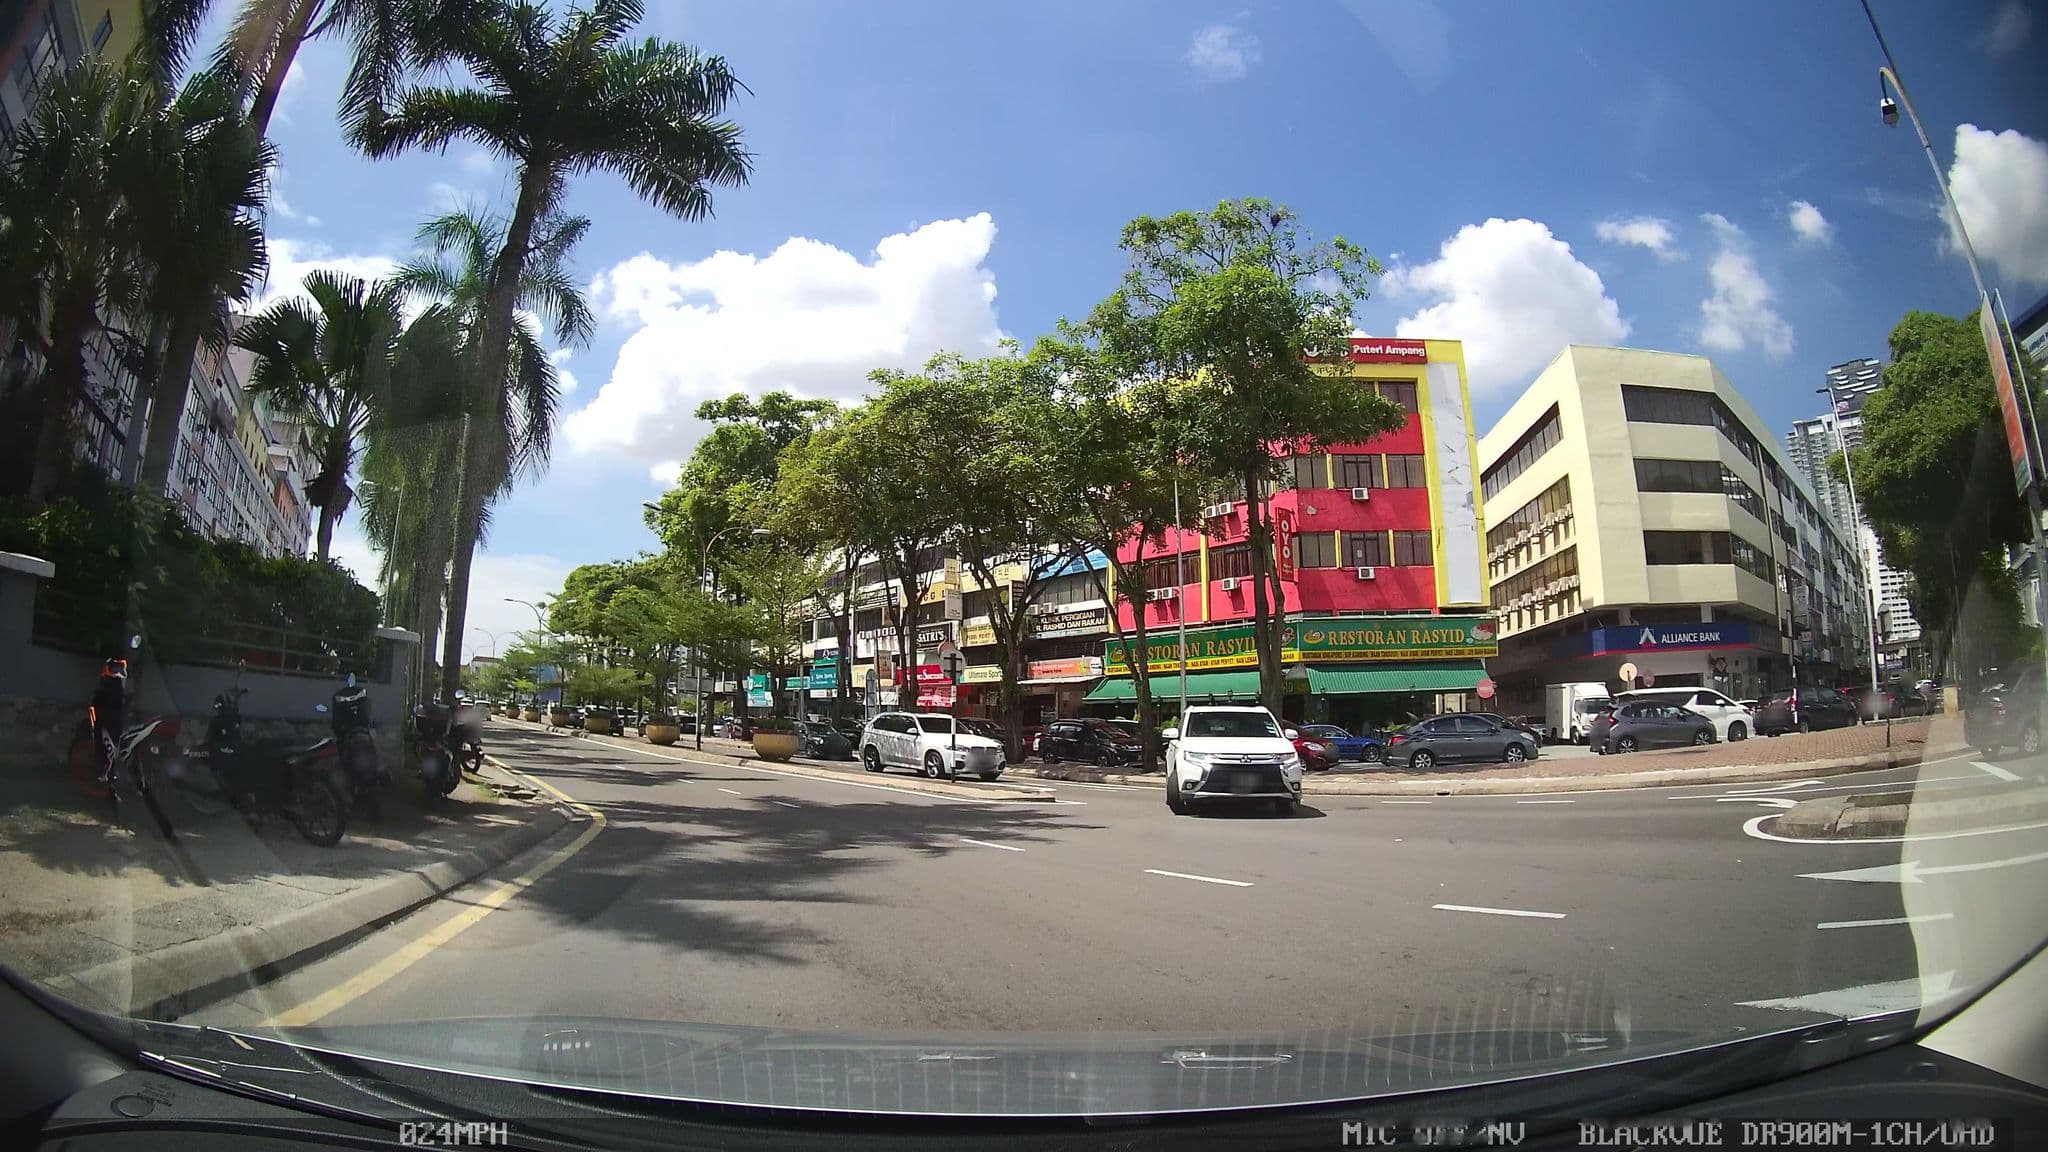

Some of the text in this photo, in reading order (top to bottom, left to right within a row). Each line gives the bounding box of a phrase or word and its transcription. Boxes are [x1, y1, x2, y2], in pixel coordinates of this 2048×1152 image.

[1353, 344, 1383, 354] Puteri
[1385, 345, 1425, 357] Ampang
[1281, 520, 1290, 559] OYO
[1043, 622, 1066, 631] RASHID
[1066, 620, 1081, 628] DAN
[1081, 617, 1105, 626] RAKAN
[1328, 628, 1465, 646] RESTORAN RASYID
[1661, 631, 1721, 644] ALLIANCE BANK
[1132, 642, 1200, 663] RSTORAN
